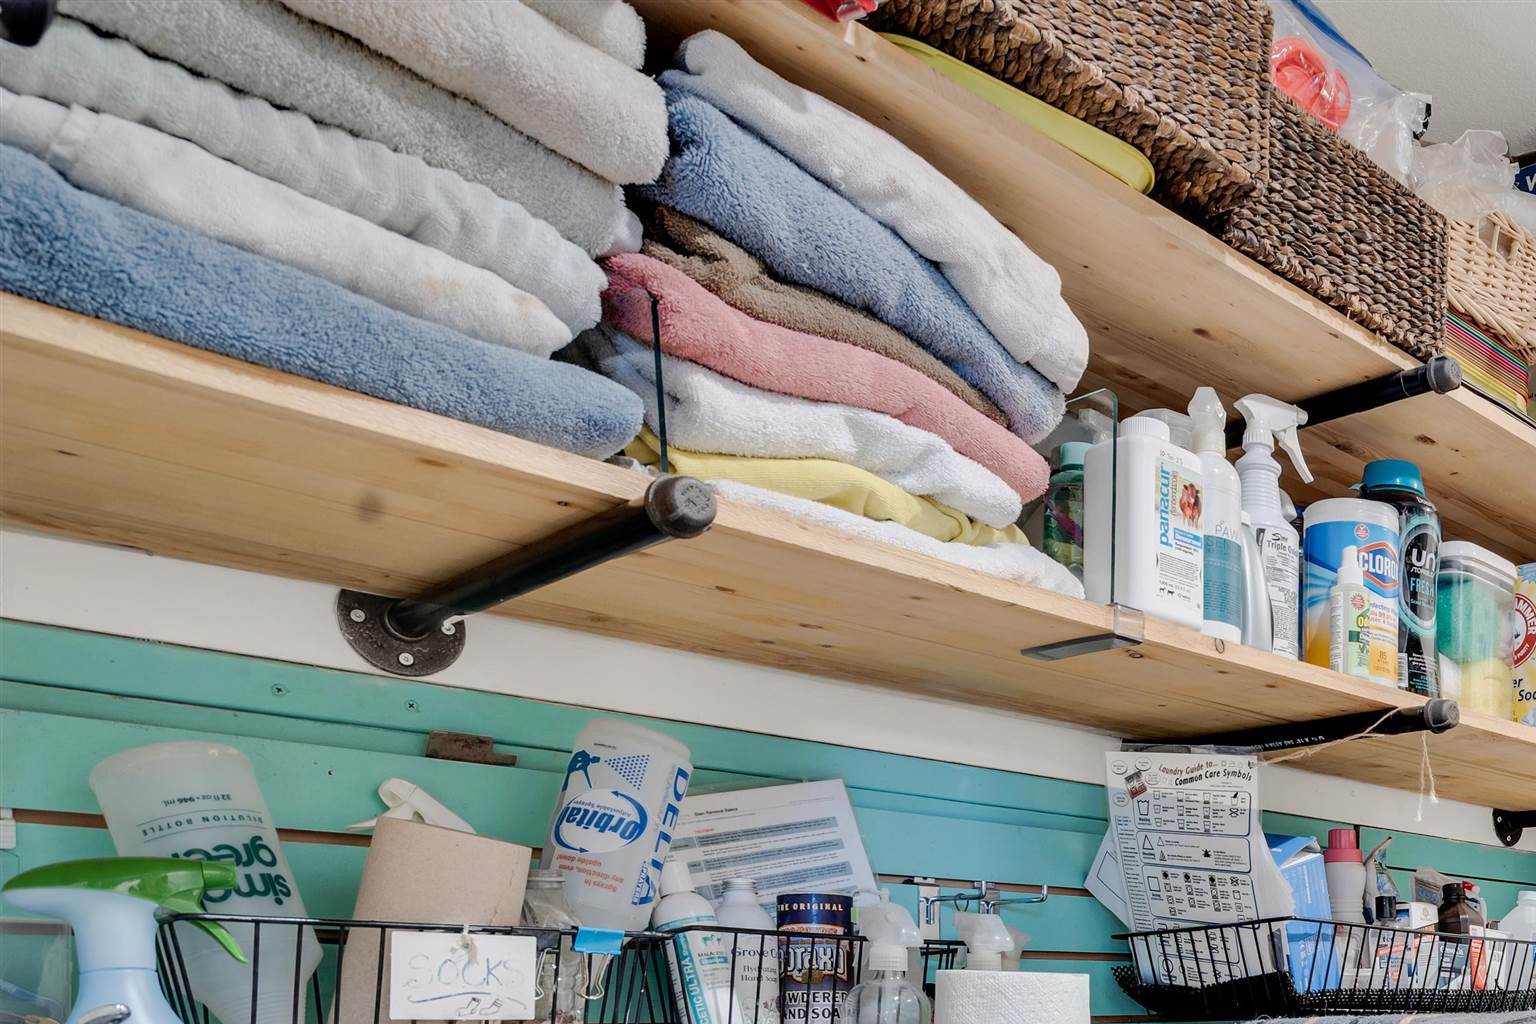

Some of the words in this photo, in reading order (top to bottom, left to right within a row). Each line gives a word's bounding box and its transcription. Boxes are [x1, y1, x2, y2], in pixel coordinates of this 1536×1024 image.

[1159, 466, 1173, 549] panacur
[1266, 540, 1287, 552] Triple
[1358, 552, 1398, 582] CLORO
[1410, 578, 1434, 596] FRESH
[1159, 763, 1184, 777] Laundry
[1185, 763, 1205, 775] Guide
[1175, 773, 1203, 786] Common
[1204, 769, 1221, 778] Care
[1222, 768, 1253, 782] Symbols
[141, 818, 193, 837] BOTTLE
[202, 815, 264, 825] DILUTION
[560, 805, 641, 841] Orbital
[792, 902, 844, 912] ORIGINAL
[408, 953, 526, 988] SOCKS
[811, 1008, 841, 1020] SOA
